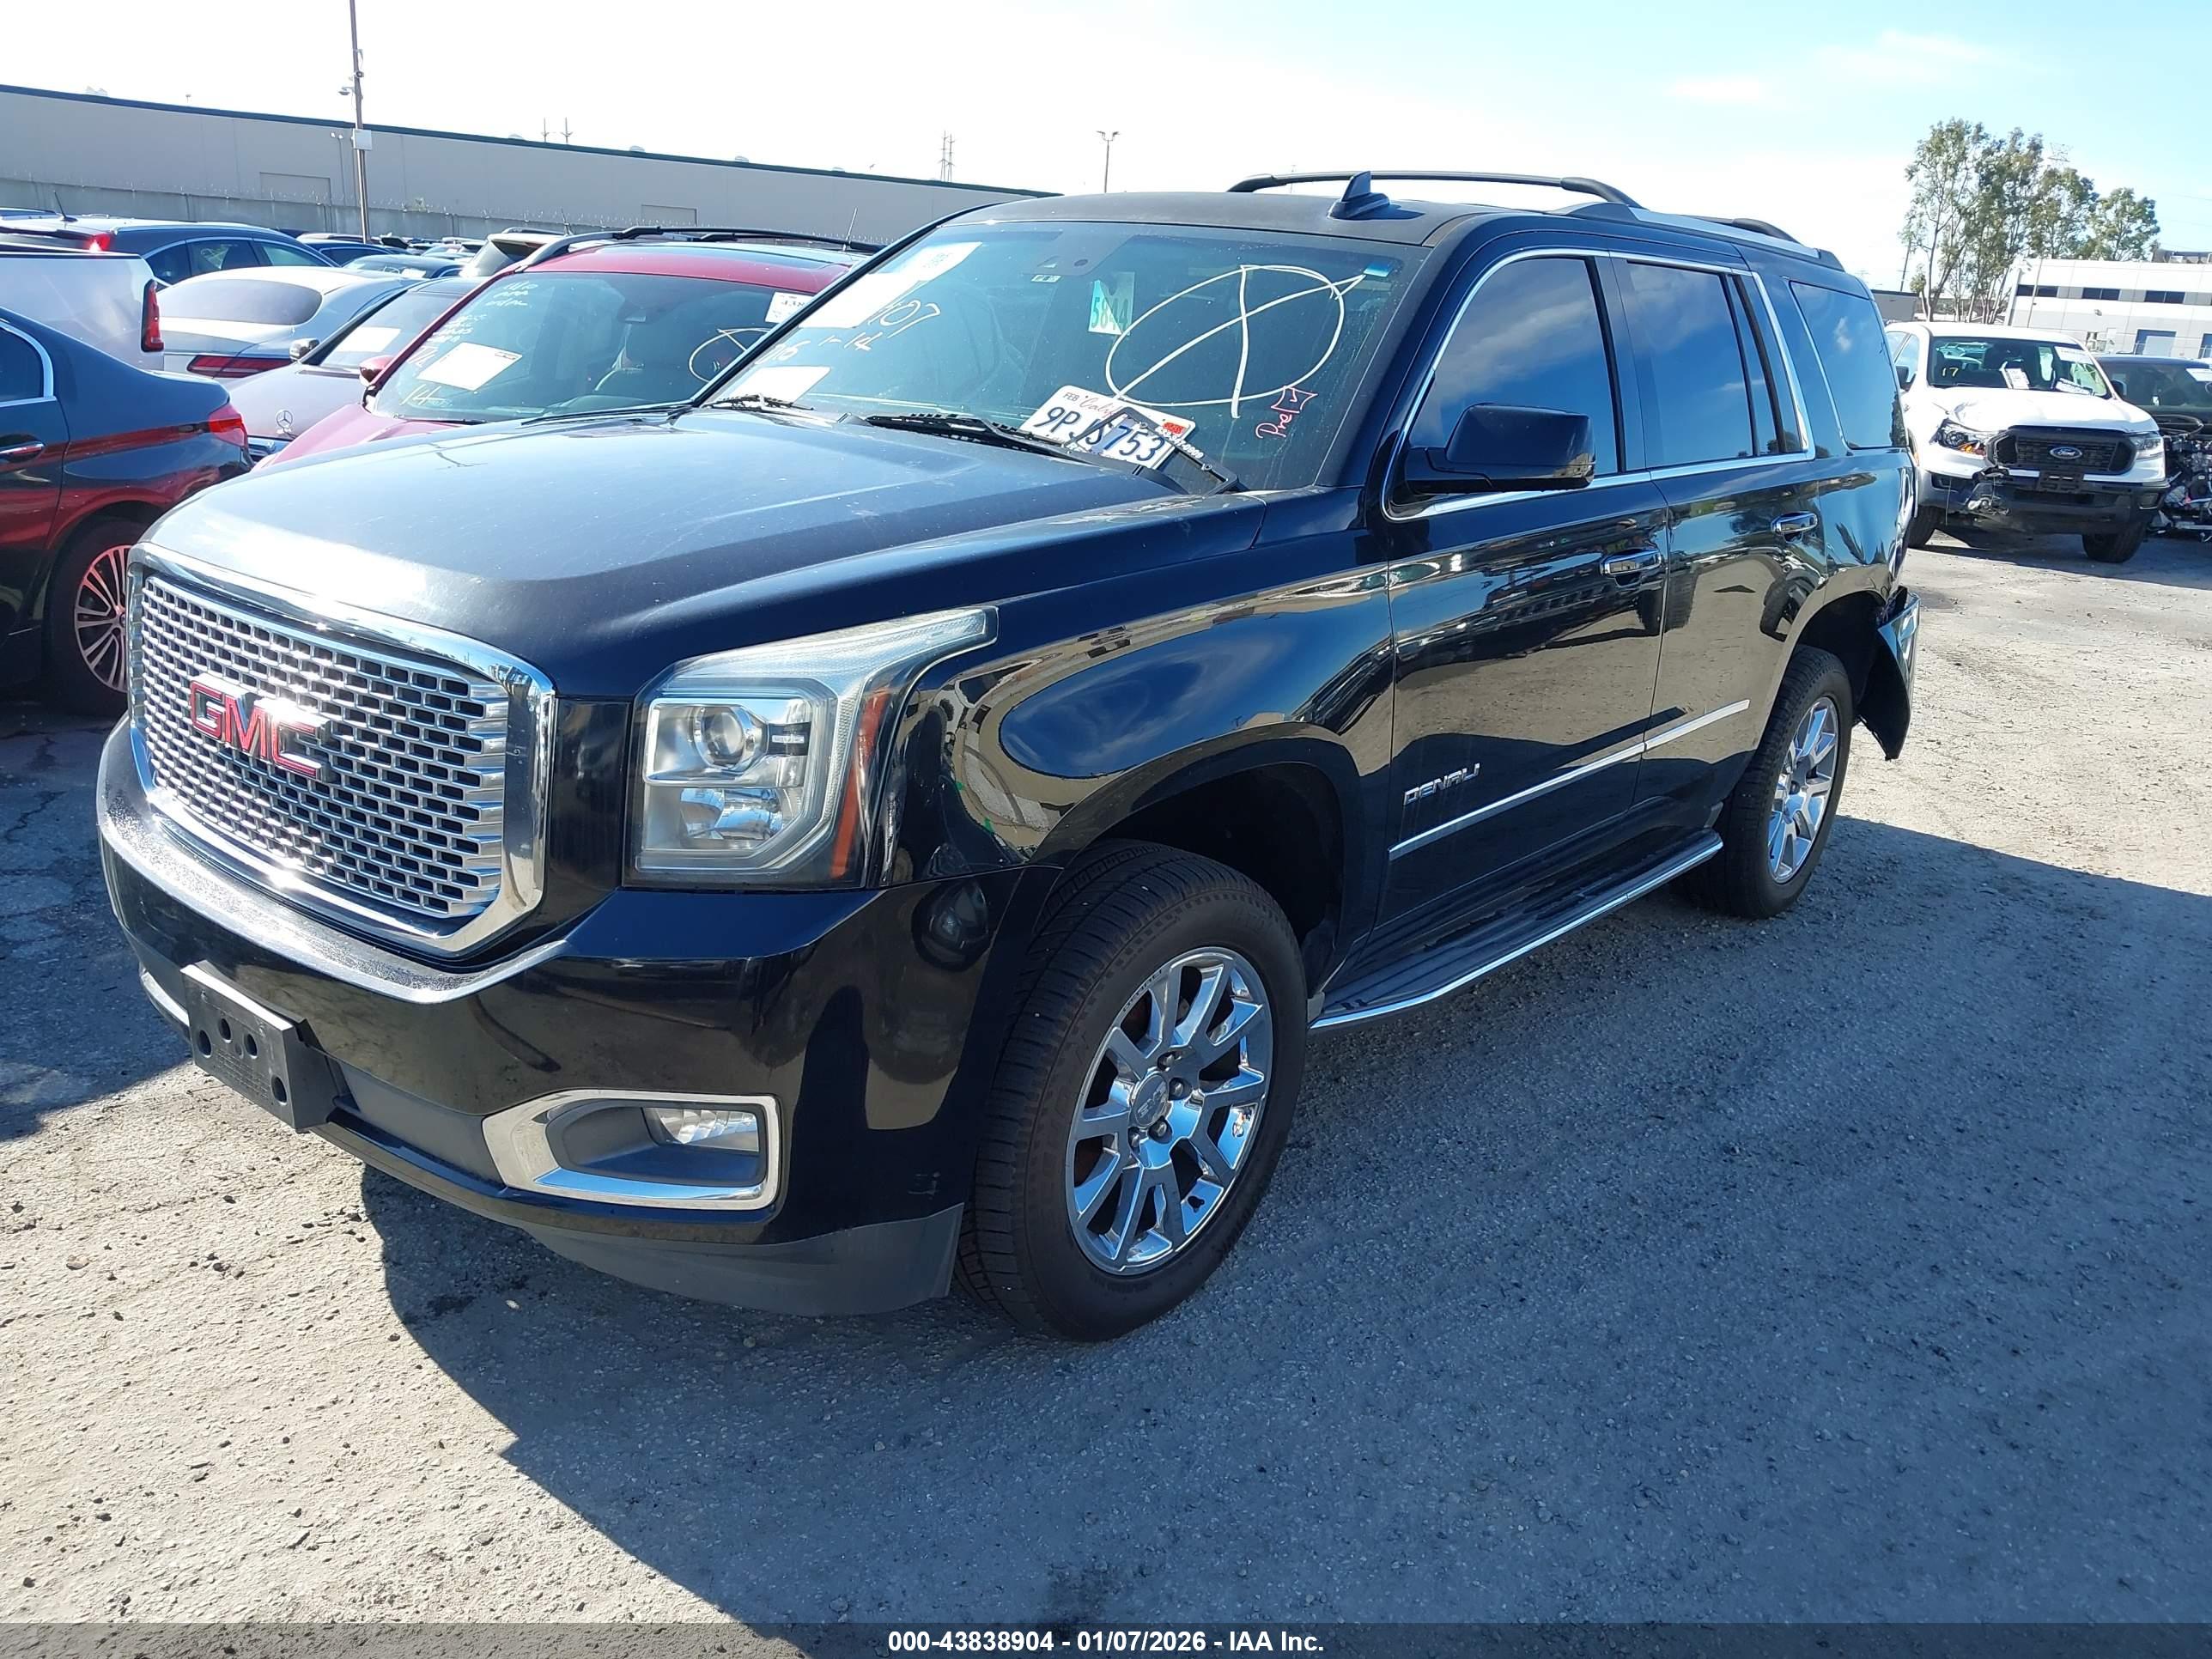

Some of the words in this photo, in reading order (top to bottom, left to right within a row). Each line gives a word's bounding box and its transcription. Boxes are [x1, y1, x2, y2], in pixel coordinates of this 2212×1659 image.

[1942, 368, 1959, 377] 17
[1062, 392, 1079, 403] FEB
[190, 677, 324, 781] GMC
[1402, 763, 1480, 806] DENALI
